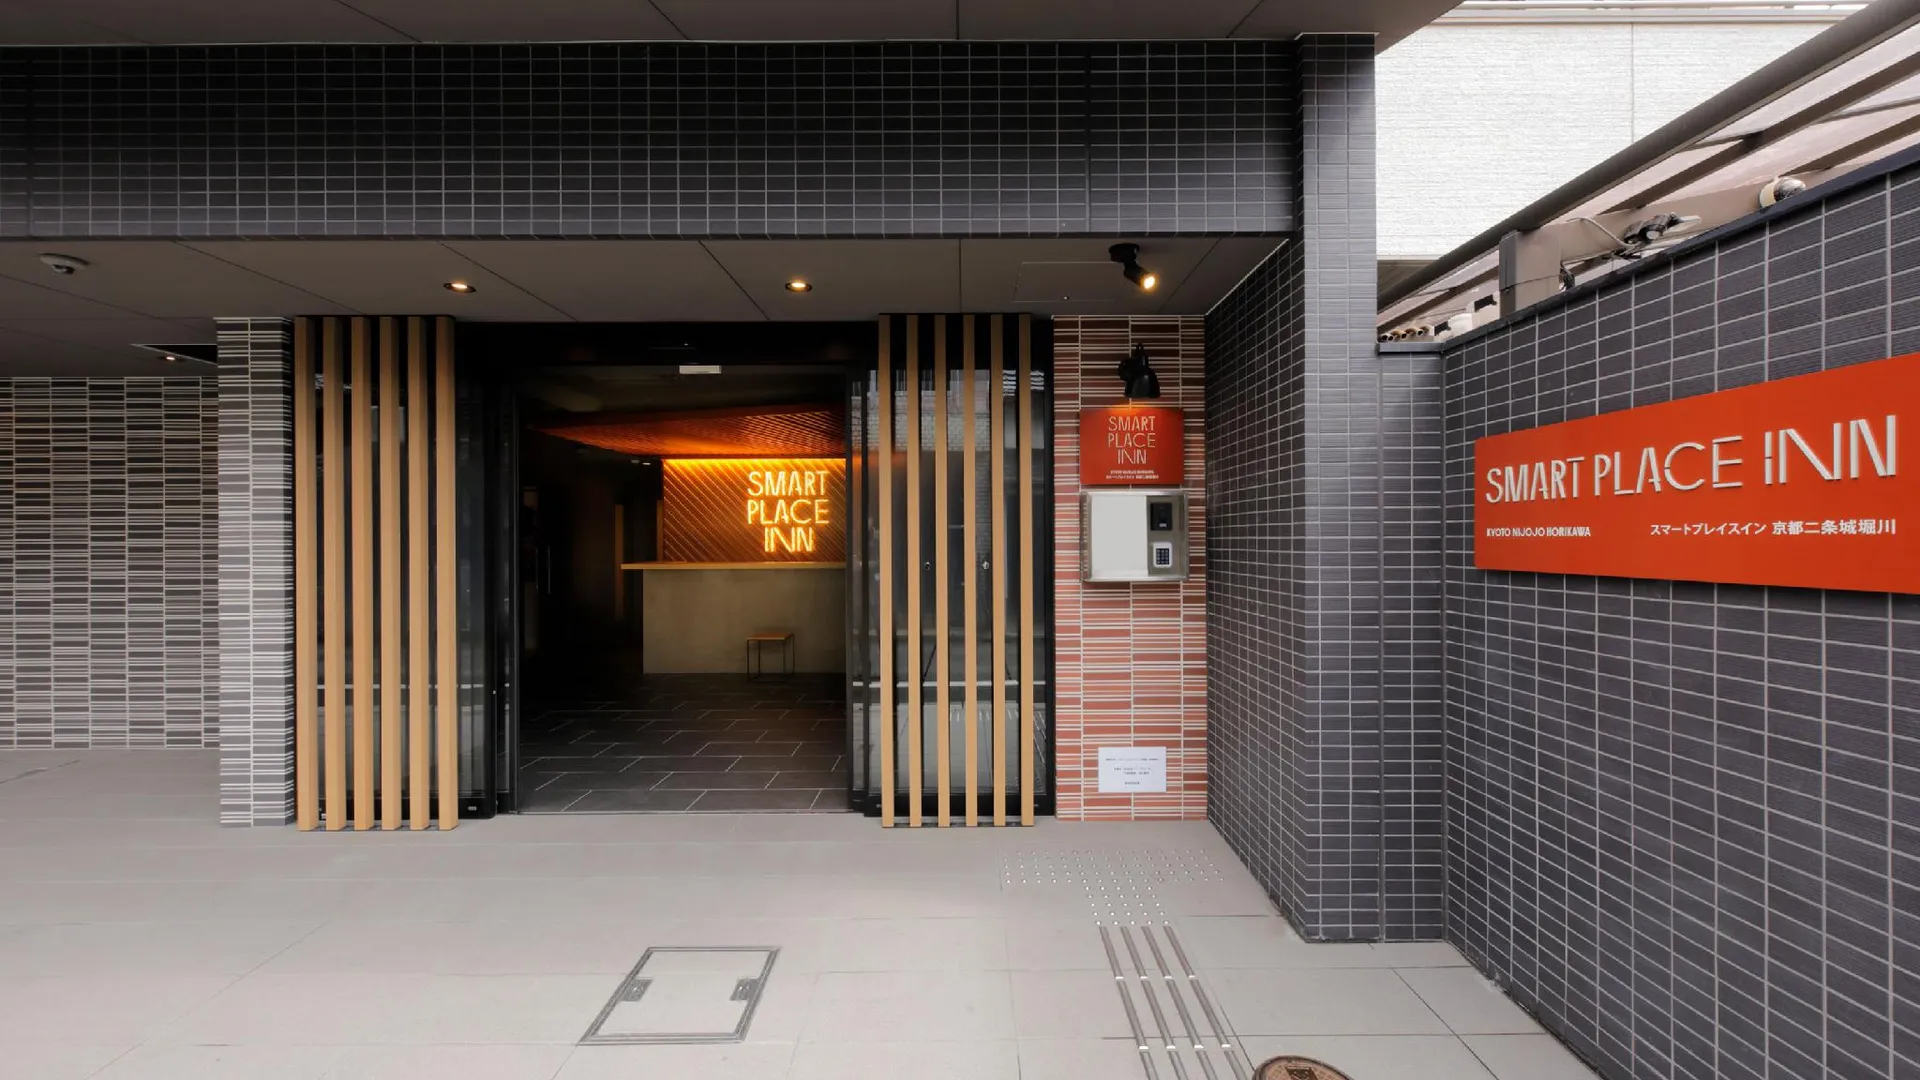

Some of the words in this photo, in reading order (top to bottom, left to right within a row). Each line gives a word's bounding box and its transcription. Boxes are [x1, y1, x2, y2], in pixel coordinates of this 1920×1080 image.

[1108, 415, 1156, 431] SMART
[1107, 432, 1156, 448] PLACE
[1117, 449, 1147, 465] INN
[1485, 456, 1585, 503] SMART
[1593, 435, 1743, 497] PLACE
[1764, 414, 1897, 486] INN
[746, 469, 830, 497] SMART
[746, 498, 830, 525] PLACE
[1486, 527, 1511, 537] KYOTO
[1512, 527, 1546, 537] NIJOJO
[1546, 526, 1591, 537] HORIKAWA
[1772, 518, 1897, 535] 京都二条城堀川
[763, 525, 815, 553] INN
